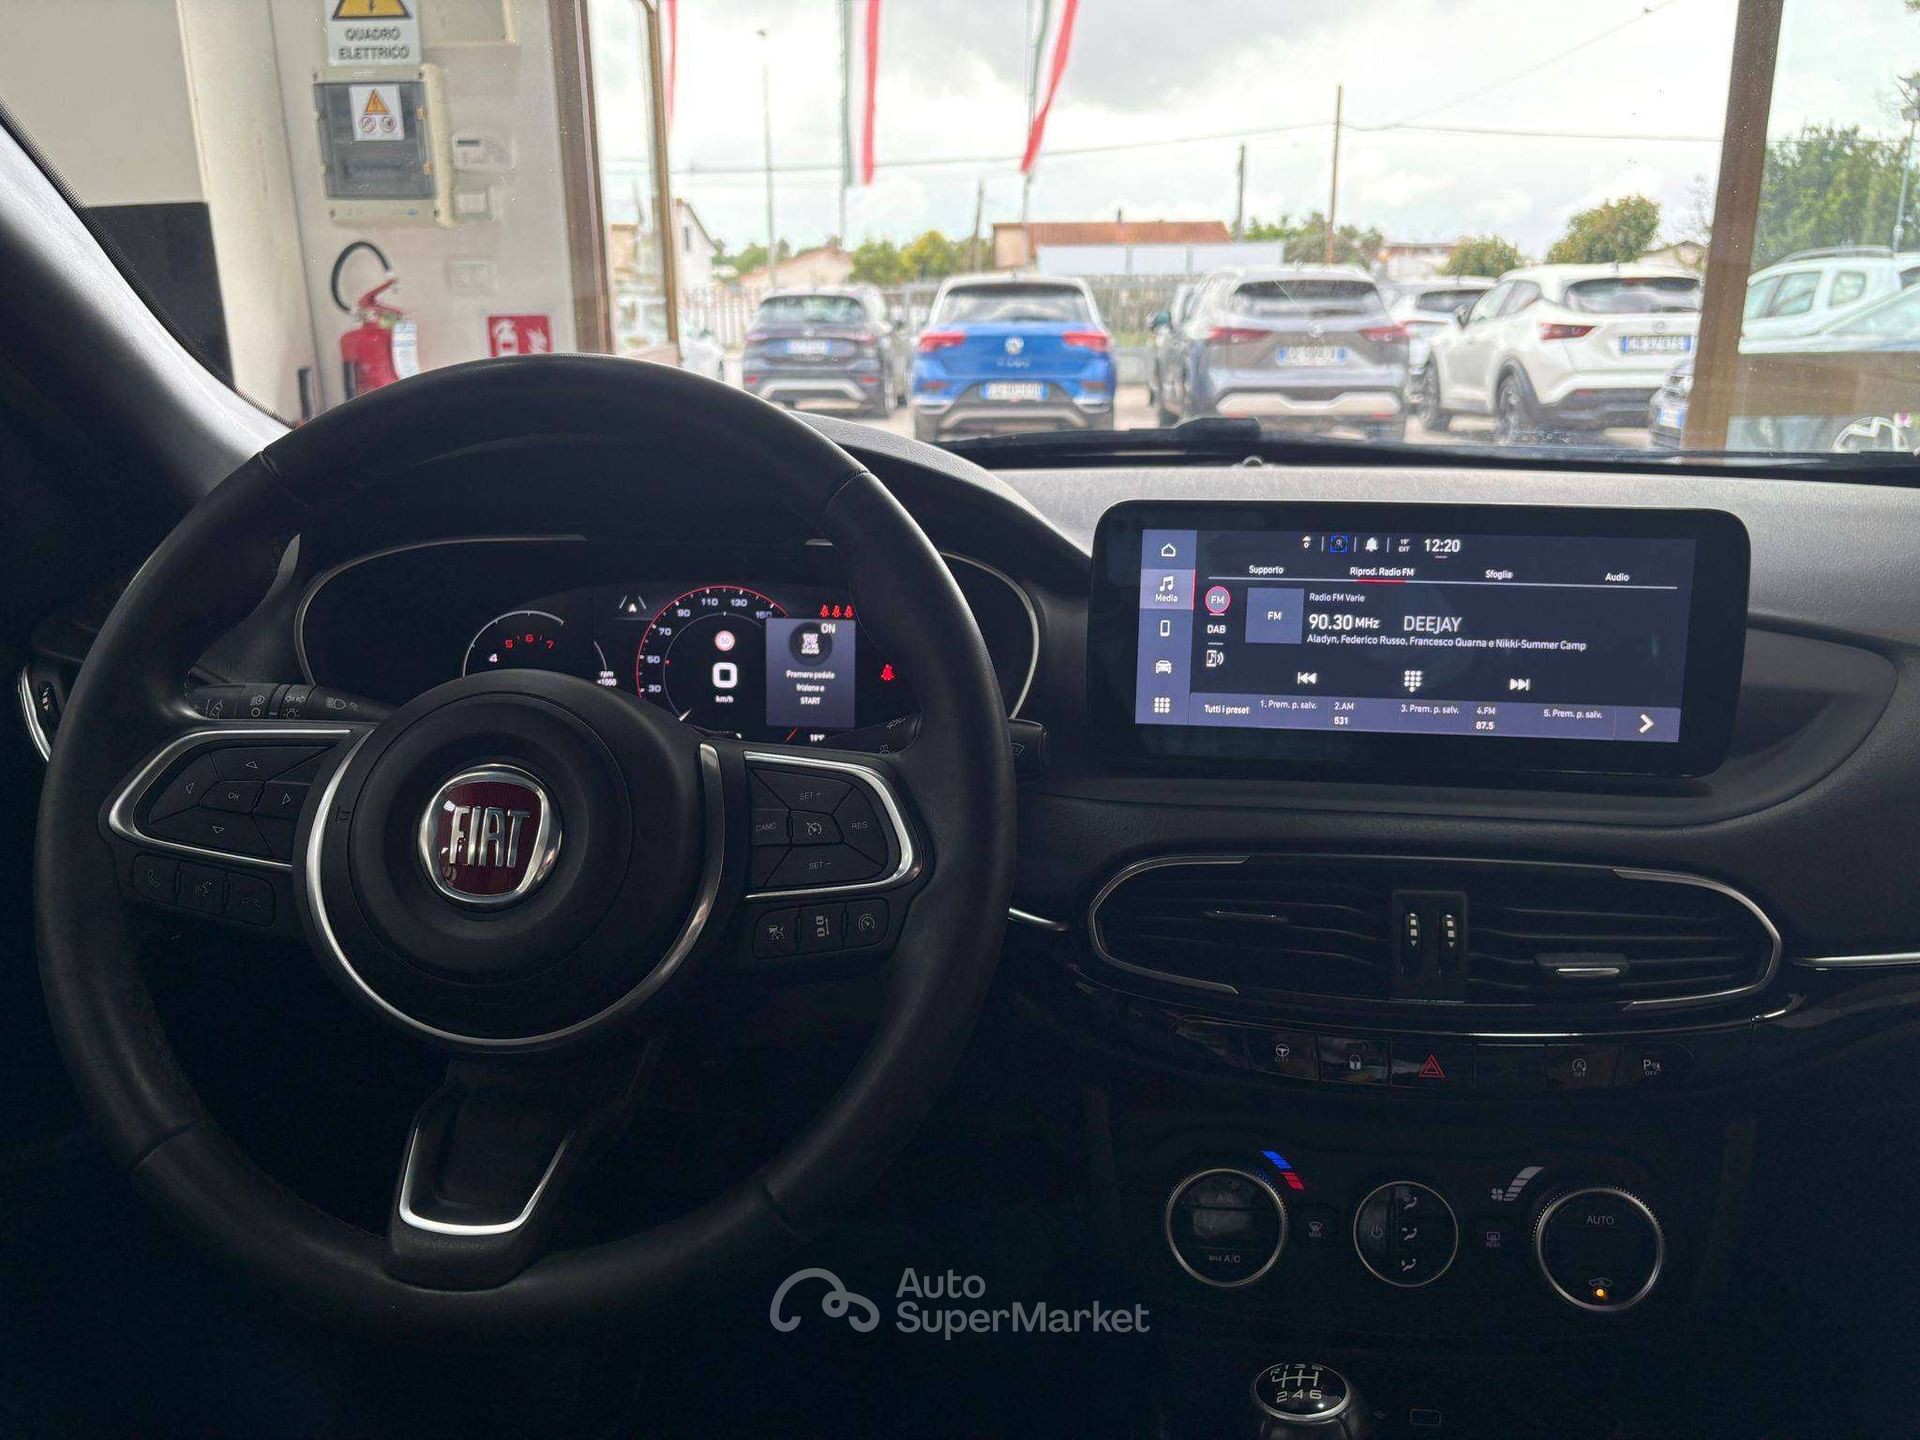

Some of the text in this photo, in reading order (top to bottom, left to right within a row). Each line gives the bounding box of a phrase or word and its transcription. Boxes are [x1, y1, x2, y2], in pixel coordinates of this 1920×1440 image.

[345, 27, 401, 41] QUADRO
[338, 45, 410, 59] ELETTRICO
[1424, 538, 1461, 552] 12:20
[1249, 565, 1284, 576] Supporto
[1349, 567, 1415, 577] Riprod. Radio FM
[1485, 569, 1513, 580] Sfoglia
[1605, 572, 1629, 582] Audio
[701, 598, 718, 607] 110
[1155, 594, 1178, 603] Media
[1210, 596, 1225, 605] FM
[1309, 593, 1365, 602] Radio FM Varie
[731, 599, 747, 607] 130
[677, 609, 690, 617] 90
[1267, 611, 1281, 621] FM
[821, 623, 836, 634] ON
[1207, 624, 1226, 634] DAB
[1309, 614, 1462, 634] 90.30 MHz DEEJAY
[658, 628, 672, 636] 70
[525, 634, 534, 643] 6
[1307, 634, 1339, 646] Aladyn,
[1341, 634, 1378, 645] Federico
[1380, 636, 1408, 646] Russo,
[1410, 636, 1453, 647] Francesco
[1488, 640, 1494, 648] e
[1495, 639, 1559, 650] Nikki-Summer
[1560, 640, 1587, 652] Camp
[504, 640, 513, 649] 5
[546, 640, 554, 650] 7
[489, 653, 498, 662] 4
[647, 655, 660, 664] 50
[712, 662, 738, 688] 0
[786, 670, 835, 680] Premere pedale
[648, 684, 661, 692] 30
[715, 695, 734, 703] km/h
[800, 697, 820, 705] START
[1204, 704, 1221, 713] Tutti
[1225, 706, 1250, 715] preset
[1260, 700, 1317, 710] 1. Prem. p. salv.
[1334, 701, 1354, 711] 2.AM
[1401, 704, 1459, 715] 3. Prem. p. salv.
[1552, 709, 1575, 718] Prem.
[1576, 711, 1584, 720] p.
[1585, 710, 1602, 719] salv.
[1333, 716, 1348, 725] 531
[799, 791, 815, 801] SET
[755, 822, 777, 832] CANC
[851, 821, 868, 831] RES
[448, 806, 530, 868] FIAT
[808, 860, 824, 870] SET
[1586, 1215, 1615, 1226] AUTO
[1223, 1253, 1241, 1264] A/C
[1276, 1389, 1322, 1404] 2 4 6
